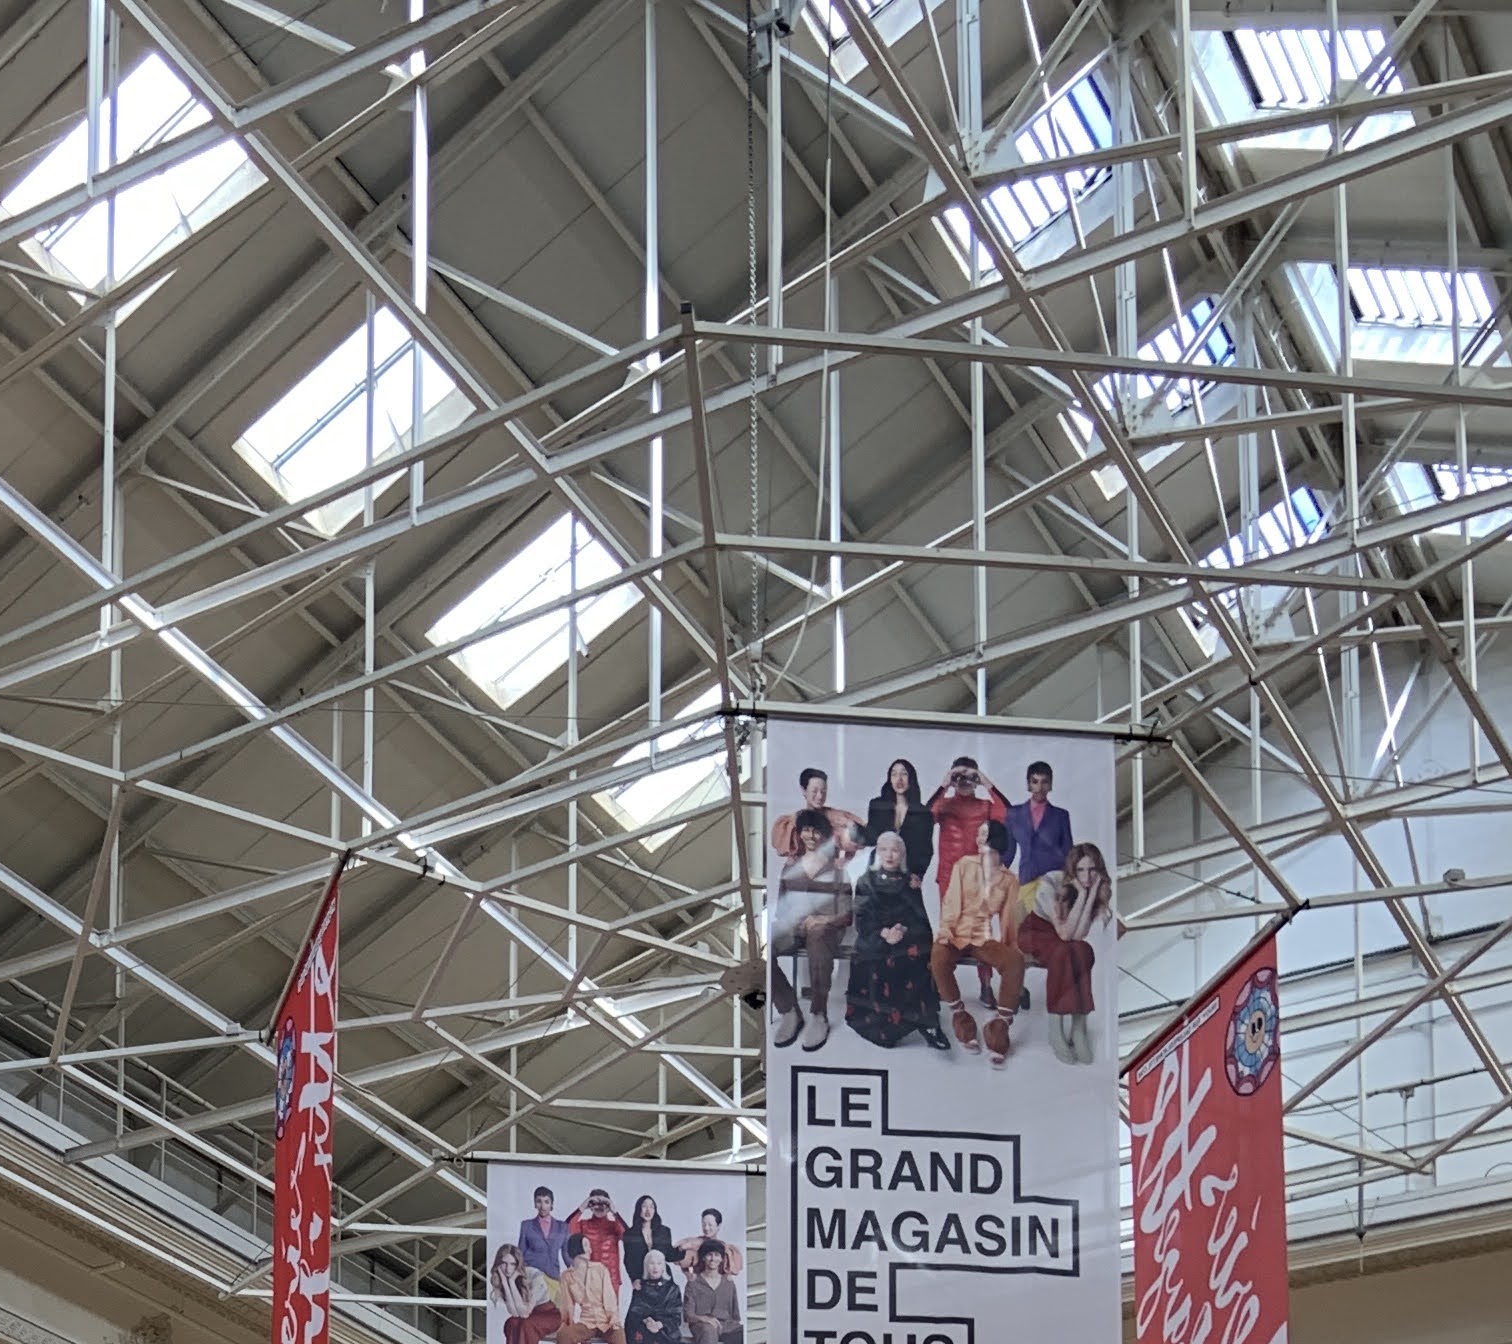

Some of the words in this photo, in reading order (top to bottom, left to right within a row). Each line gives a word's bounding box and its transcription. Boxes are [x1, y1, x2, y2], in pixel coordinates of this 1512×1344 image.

[807, 1085, 872, 1128] LE
[805, 1146, 1003, 1194] GRAND
[806, 1207, 1059, 1259] MAGASIN
[806, 1268, 879, 1312] DE
